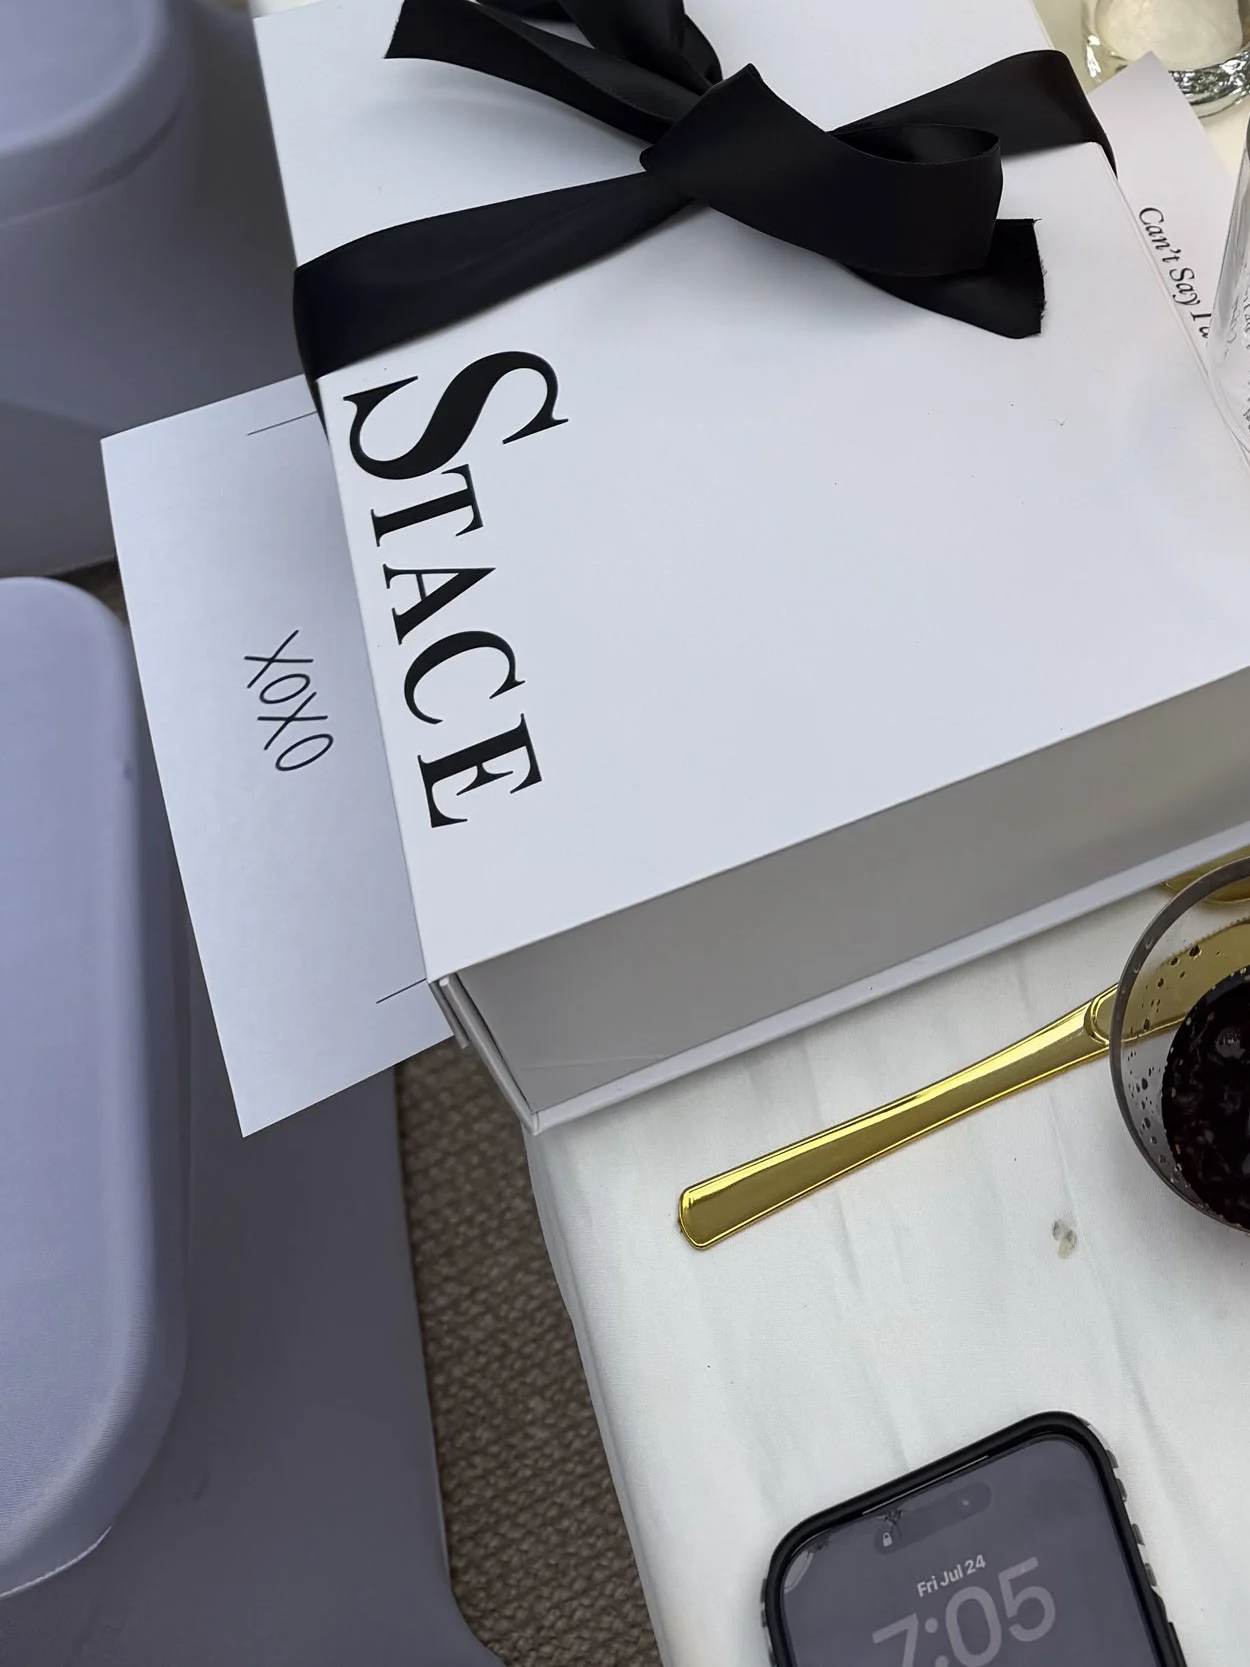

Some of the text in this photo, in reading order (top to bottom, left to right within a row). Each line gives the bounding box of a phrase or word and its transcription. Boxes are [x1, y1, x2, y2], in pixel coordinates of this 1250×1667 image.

[1139, 207, 1182, 263] Can't
[1169, 266, 1202, 307] Say
[342, 351, 569, 829] STACE
[243, 629, 334, 772] XOXO
[872, 1556, 1056, 1667] 7:05
[917, 1554, 986, 1598] Fri Jul 24
